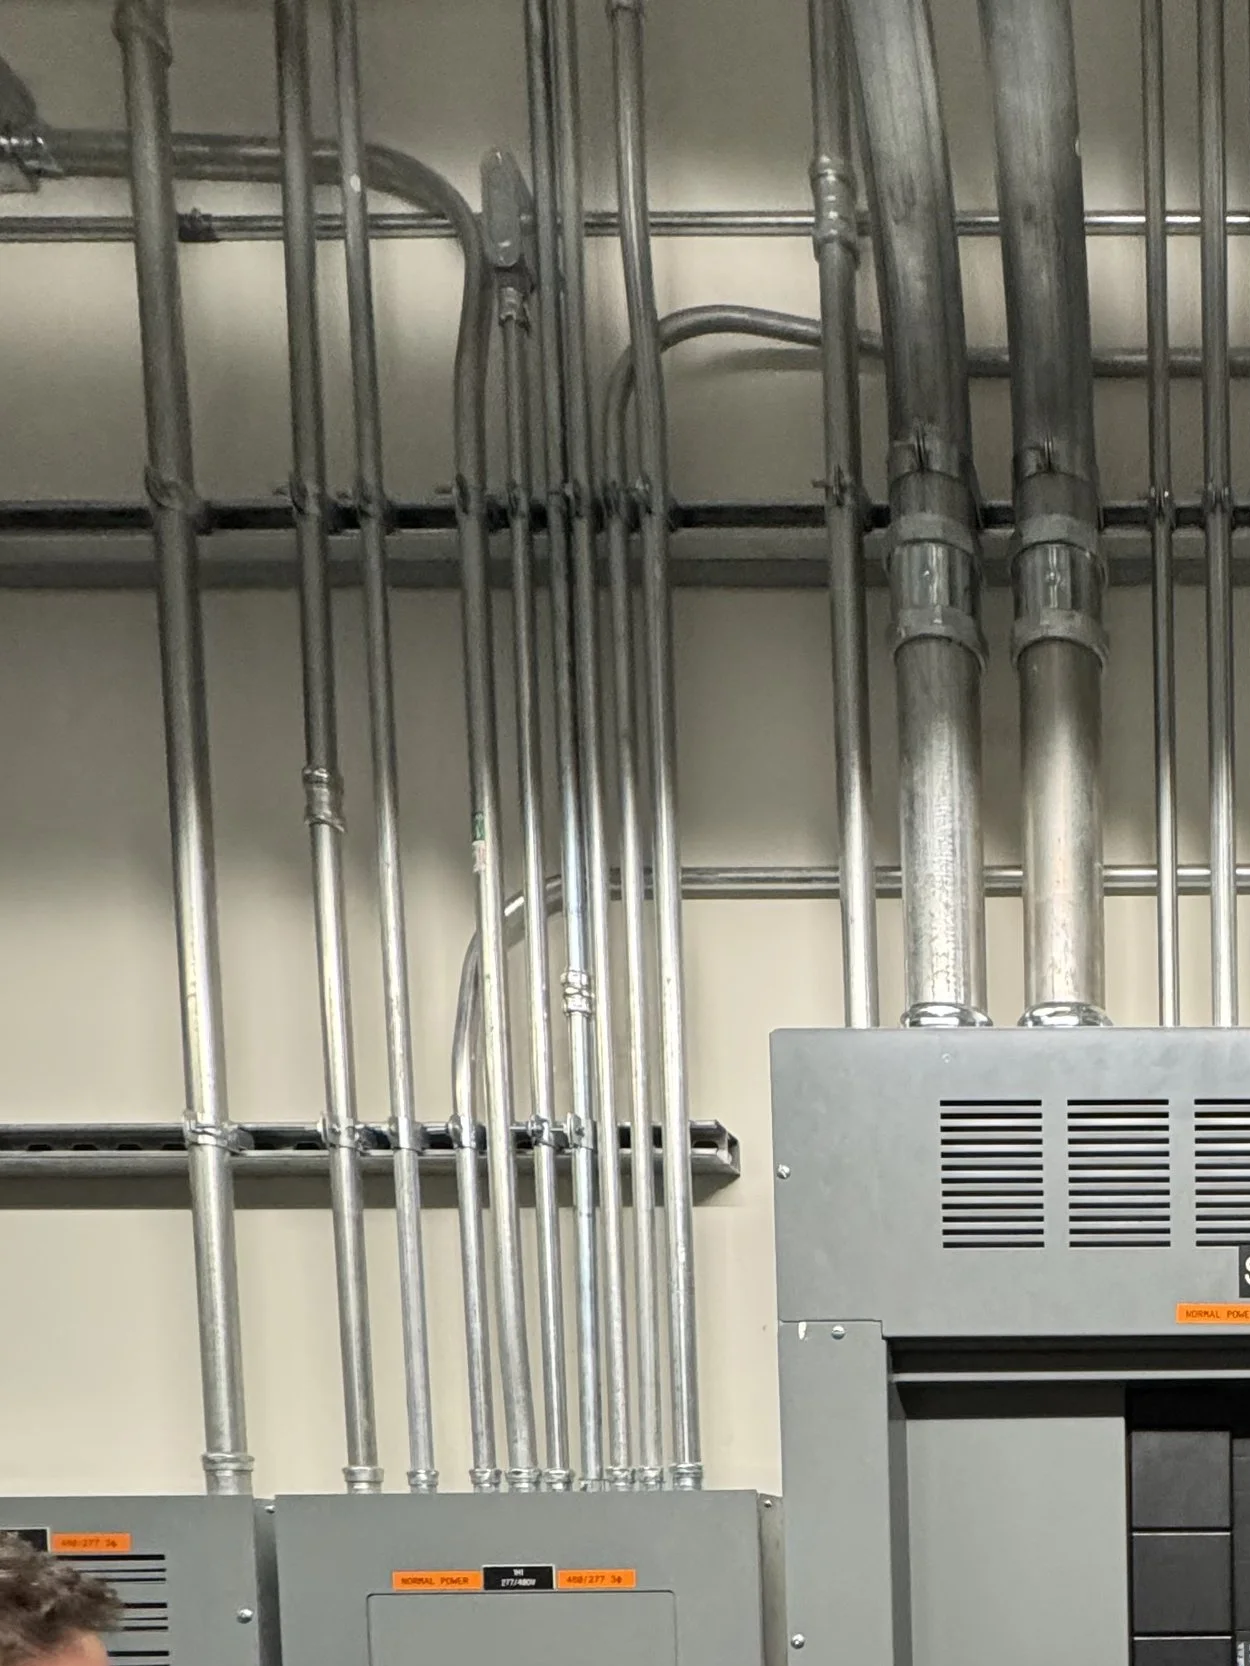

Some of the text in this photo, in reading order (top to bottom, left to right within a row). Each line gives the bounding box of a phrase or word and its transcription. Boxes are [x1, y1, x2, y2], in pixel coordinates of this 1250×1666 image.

[1186, 1309, 1221, 1319] NORMAL
[401, 1576, 469, 1585] NORMAL POWER
